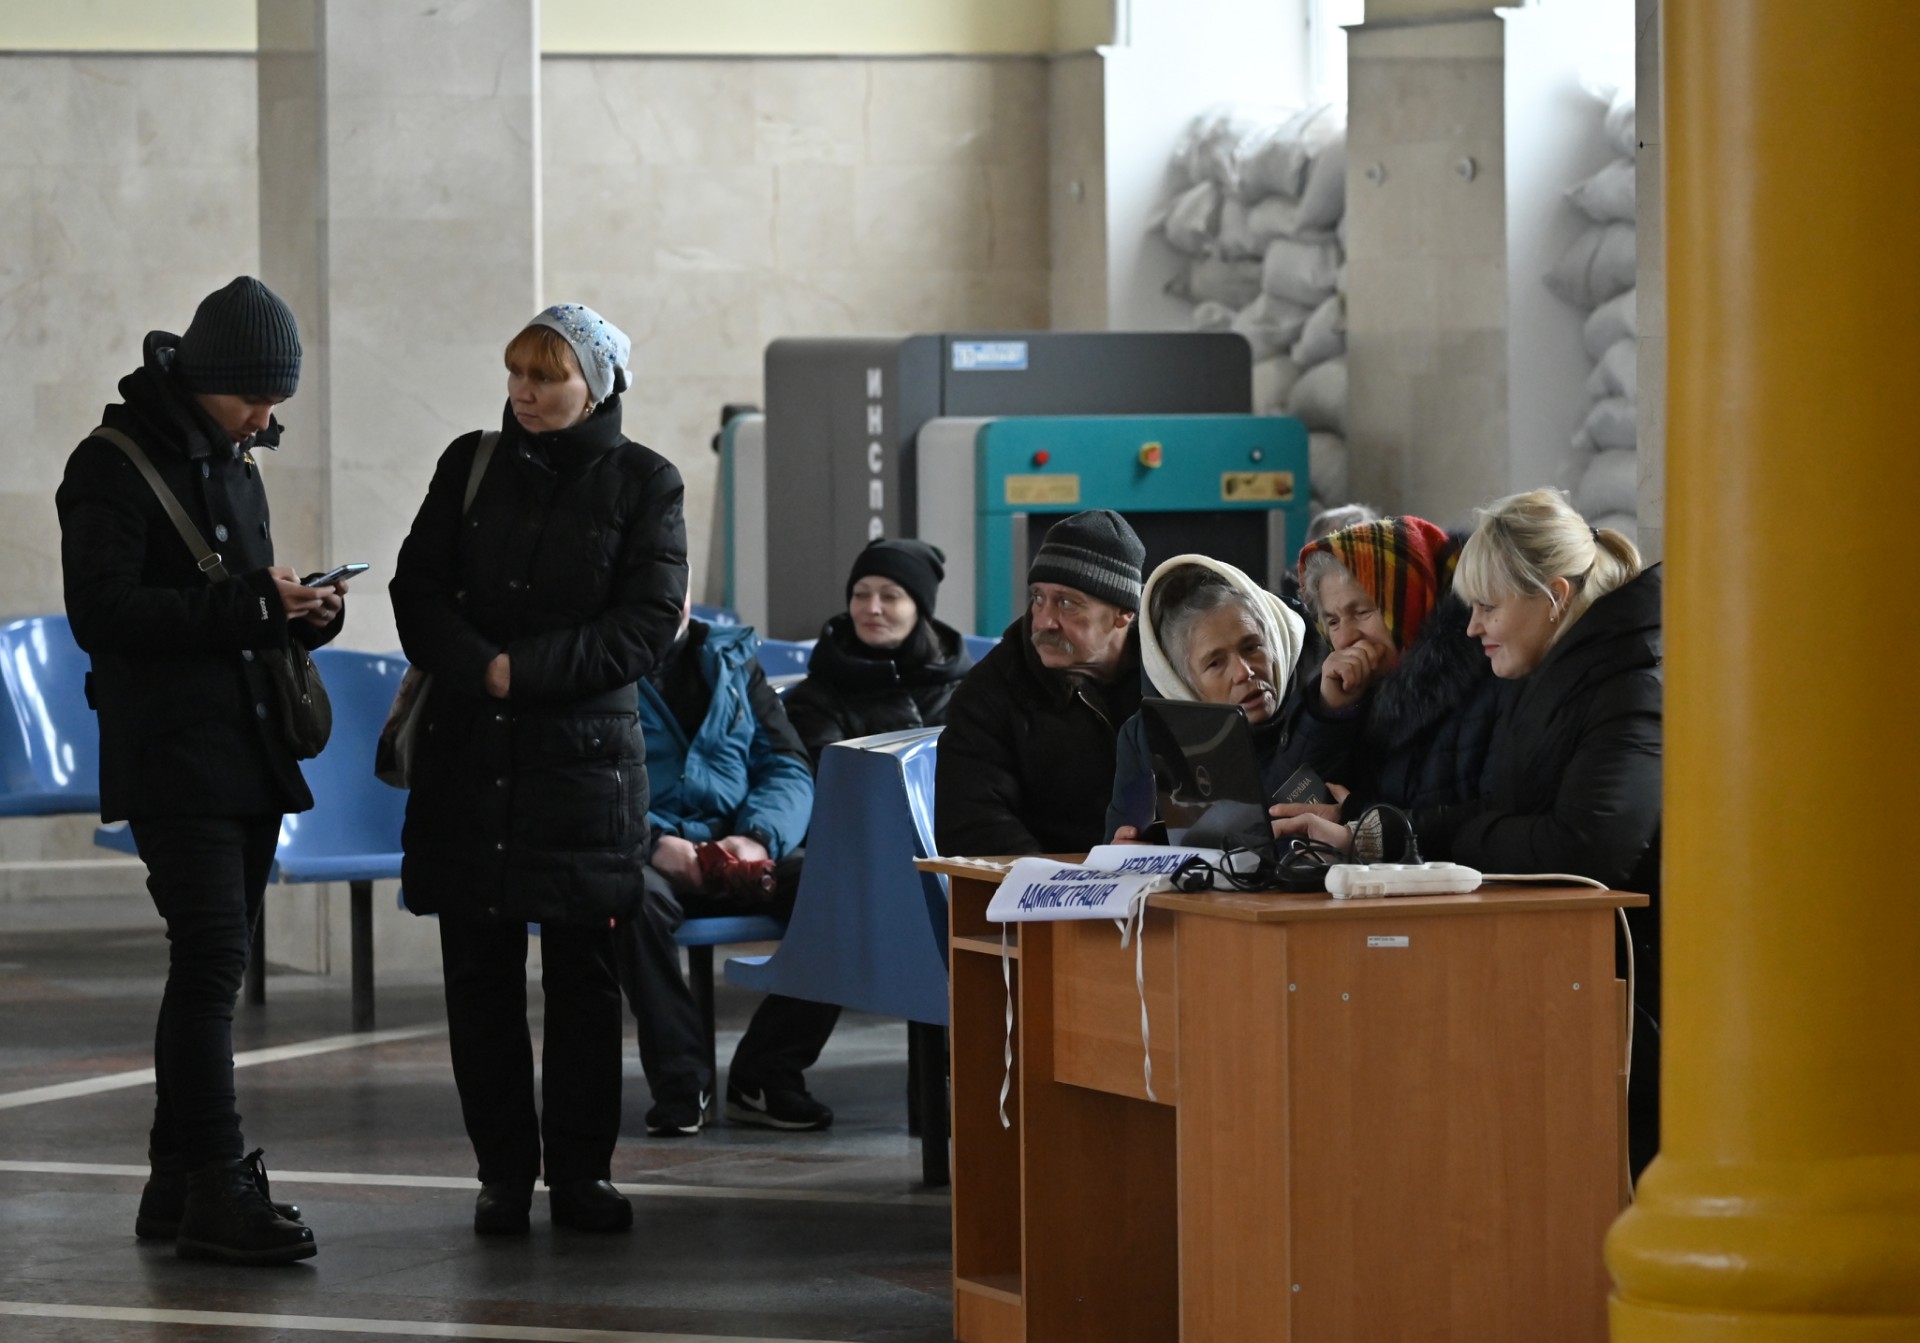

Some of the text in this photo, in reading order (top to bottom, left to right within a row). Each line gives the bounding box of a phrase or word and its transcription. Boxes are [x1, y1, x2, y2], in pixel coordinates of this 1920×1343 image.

[1286, 777, 1312, 802] УКРАЇНА
[1115, 853, 1200, 875] ХЕРСОНСЬ
[1016, 882, 1120, 912] АДМІНІСТРАЦІЯ
